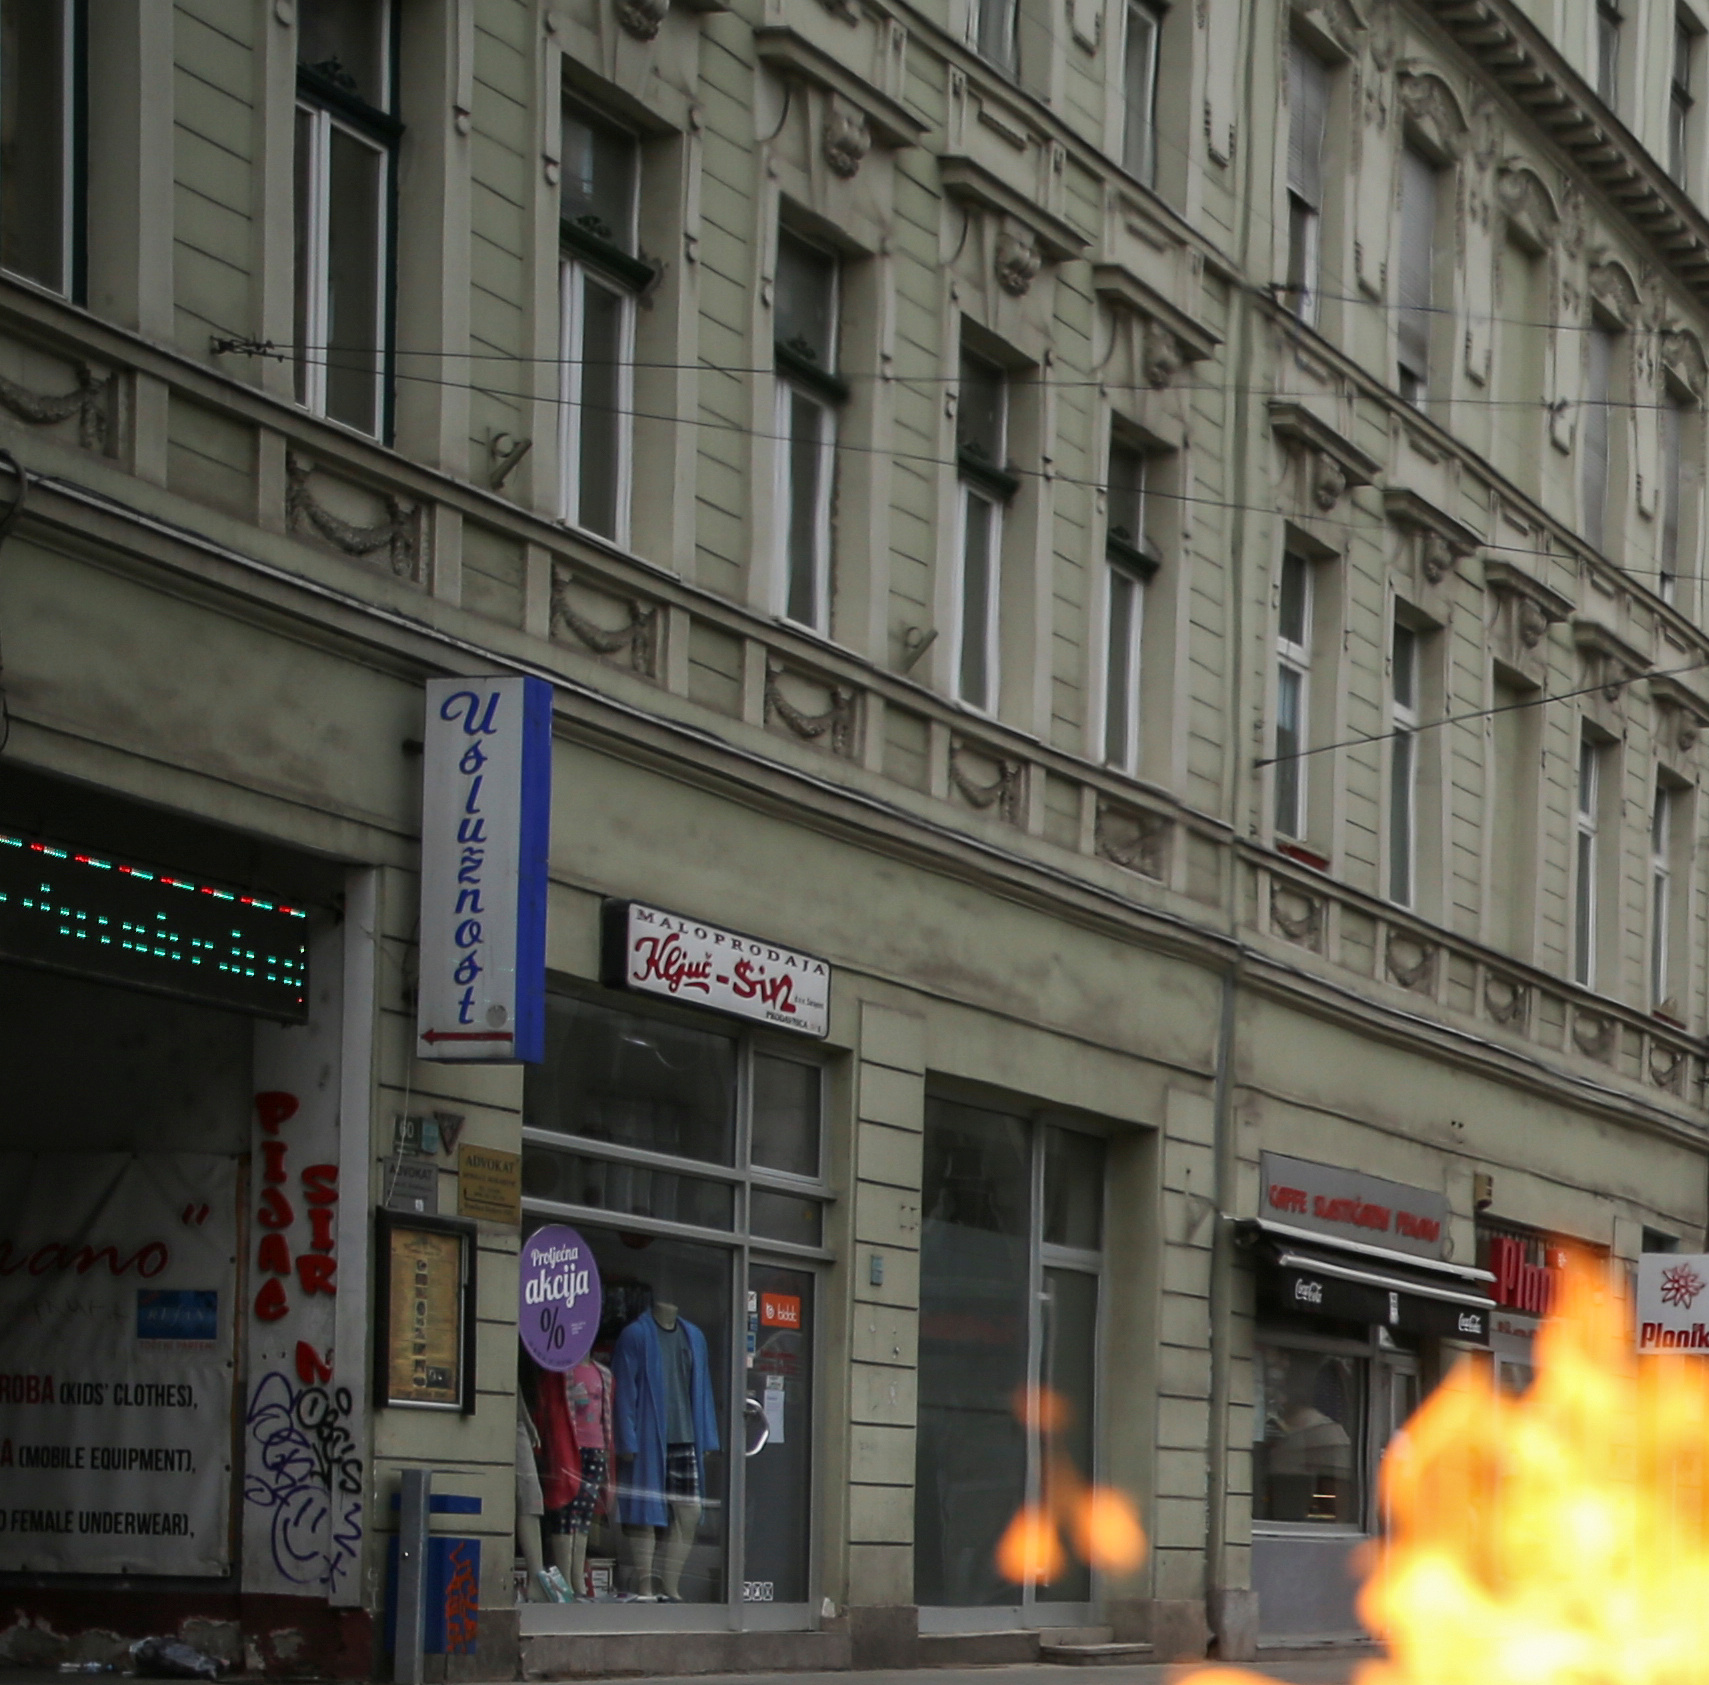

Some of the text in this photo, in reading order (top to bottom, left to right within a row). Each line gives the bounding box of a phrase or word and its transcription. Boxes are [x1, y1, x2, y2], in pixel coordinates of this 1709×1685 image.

[440, 690, 501, 1025] Uslužnost
[637, 909, 825, 976] MALOPRODAJA
[389, 1163, 433, 1180] ADVOKAT
[466, 1155, 514, 1174] ADVOKAT
[525, 1263, 590, 1309] akcija
[540, 1307, 566, 1352] %
[113, 1383, 198, 1410] CLOTHES),
[19, 1446, 86, 1469] (MOBILE
[90, 1447, 196, 1474] EQUIPMENT),
[11, 1509, 74, 1534] FEMALE
[79, 1511, 195, 1539] UNDERWEAR),
